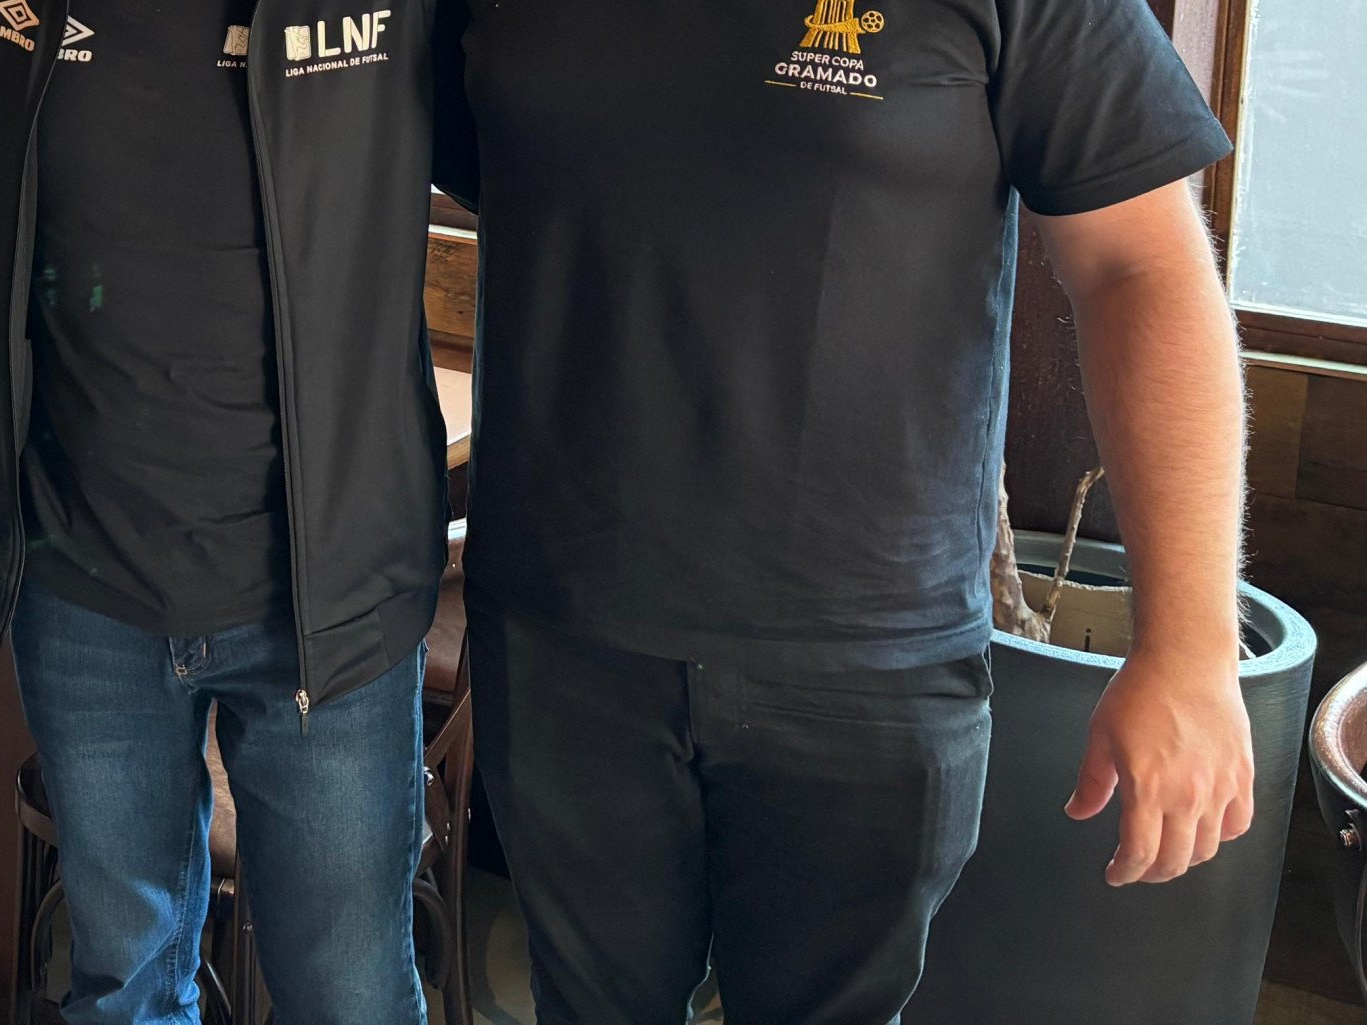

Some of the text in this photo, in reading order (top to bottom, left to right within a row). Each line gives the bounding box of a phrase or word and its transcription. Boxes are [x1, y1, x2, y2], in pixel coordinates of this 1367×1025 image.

[316, 9, 392, 58] LNF
[216, 59, 237, 68] LIGA
[285, 53, 389, 77] LIGA NACIONAL DE FUTSAL
[790, 51, 864, 71] SUPER COPA
[774, 62, 878, 88] GRAMADO
[800, 81, 848, 95] DE FUTSAL
